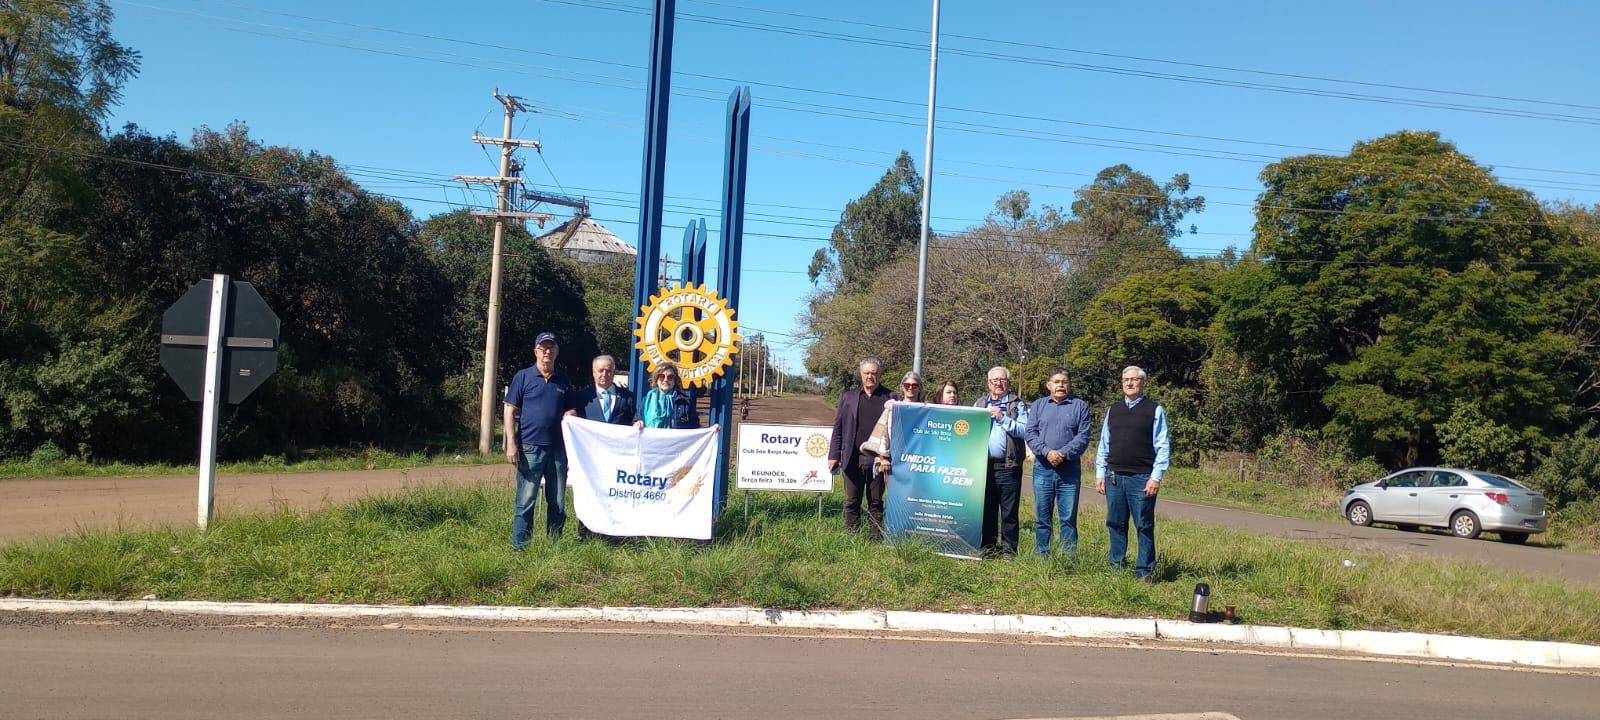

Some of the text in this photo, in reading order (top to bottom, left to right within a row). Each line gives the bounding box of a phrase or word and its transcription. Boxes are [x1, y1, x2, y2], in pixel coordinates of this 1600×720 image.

[667, 293, 715, 309] ROTARY
[927, 420, 953, 430] Rotary
[761, 433, 802, 447] Rotary
[900, 453, 937, 464] UNIDOS
[910, 463, 968, 477] PARA FAZER
[616, 469, 669, 490] Rotary
[943, 475, 974, 487] O BEM
[609, 487, 667, 501] Distrito 4660
